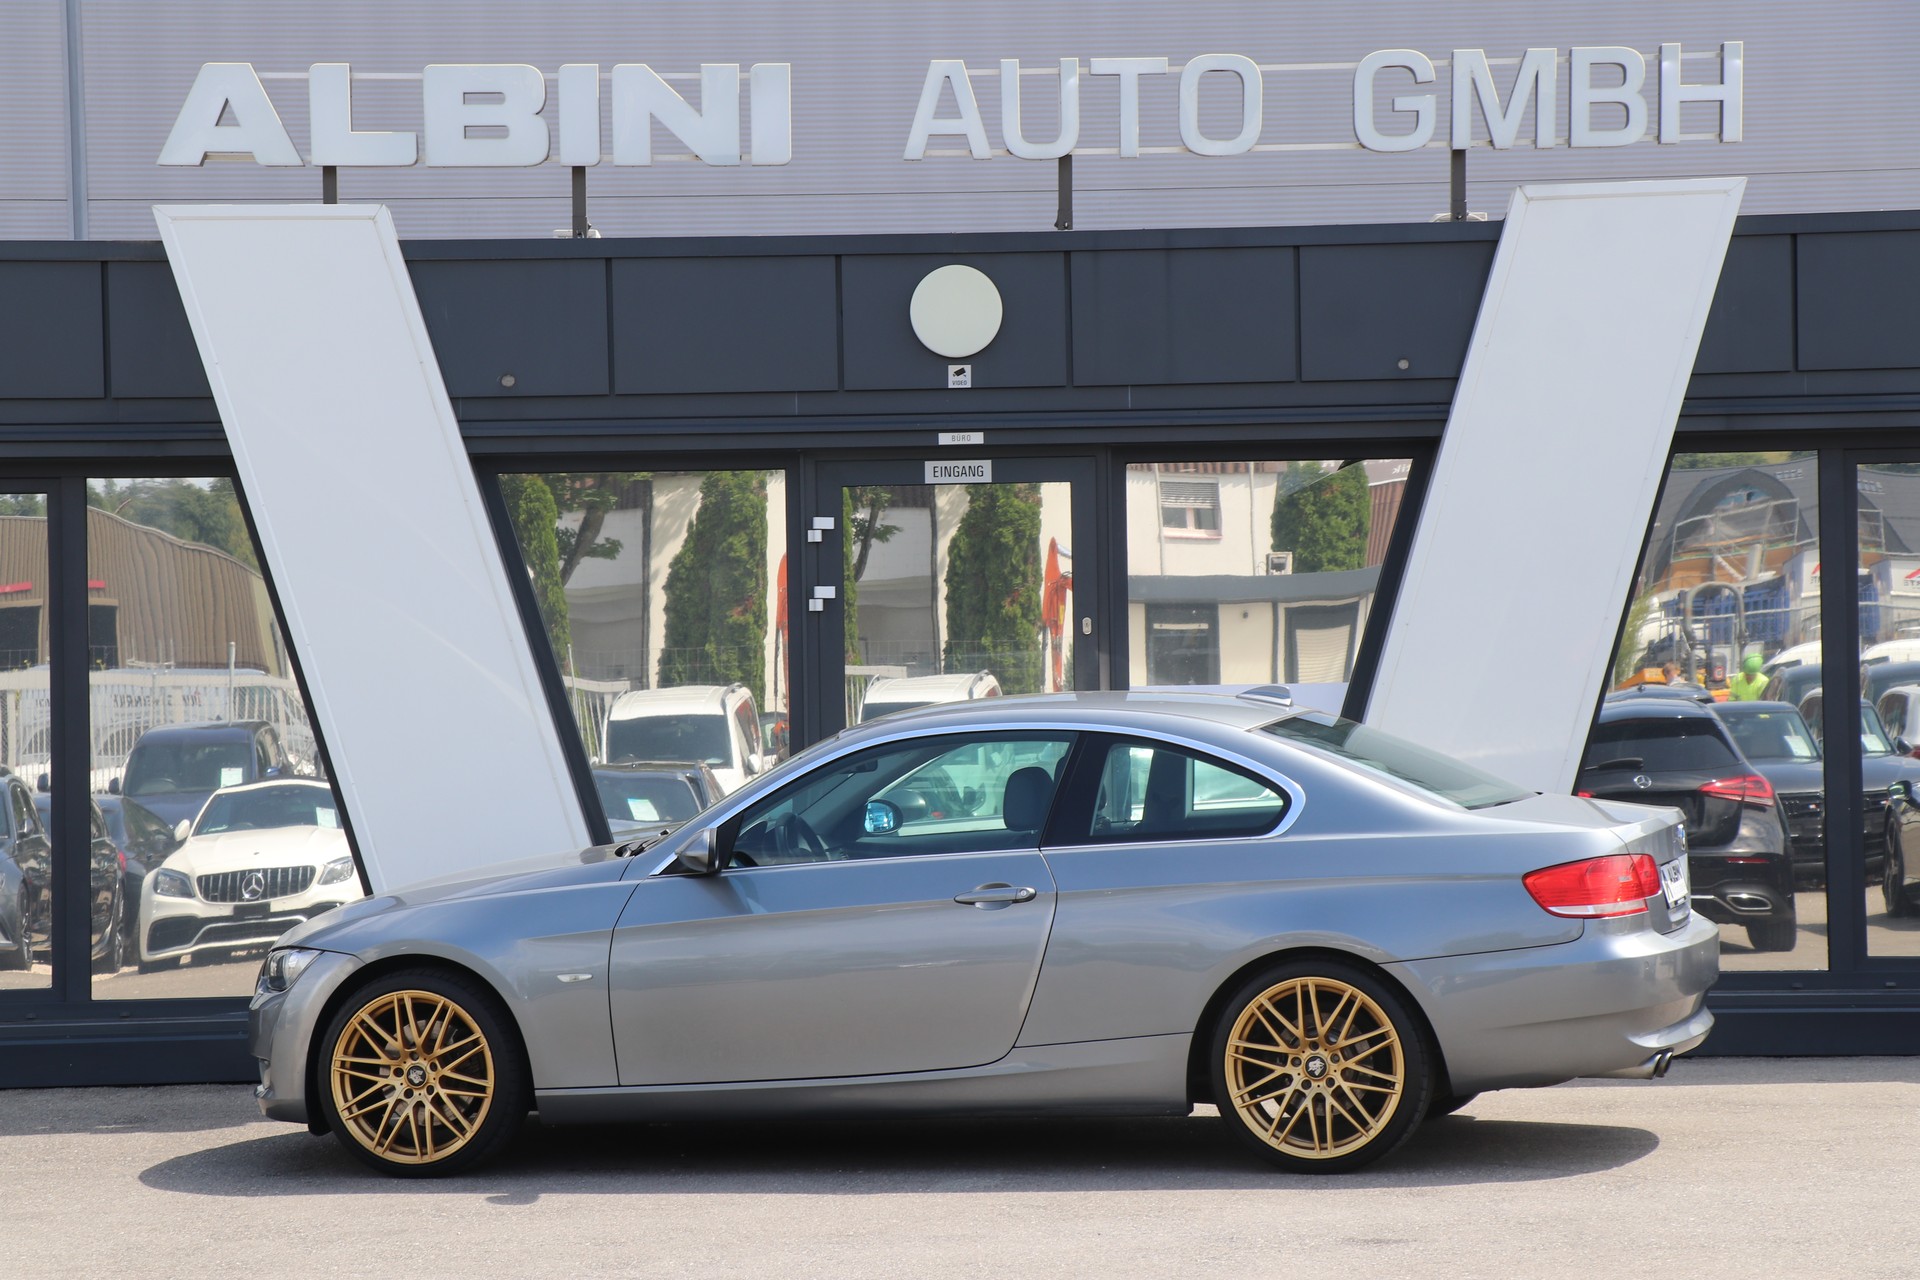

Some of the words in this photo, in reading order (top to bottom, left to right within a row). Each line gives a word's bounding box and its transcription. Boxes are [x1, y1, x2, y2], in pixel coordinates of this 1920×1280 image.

[156, 62, 793, 167] ALBINI
[903, 53, 1263, 161] AUTO
[1353, 40, 1744, 152] GMBH
[951, 433, 971, 442] BÜRO
[933, 465, 984, 478] EINGANG
